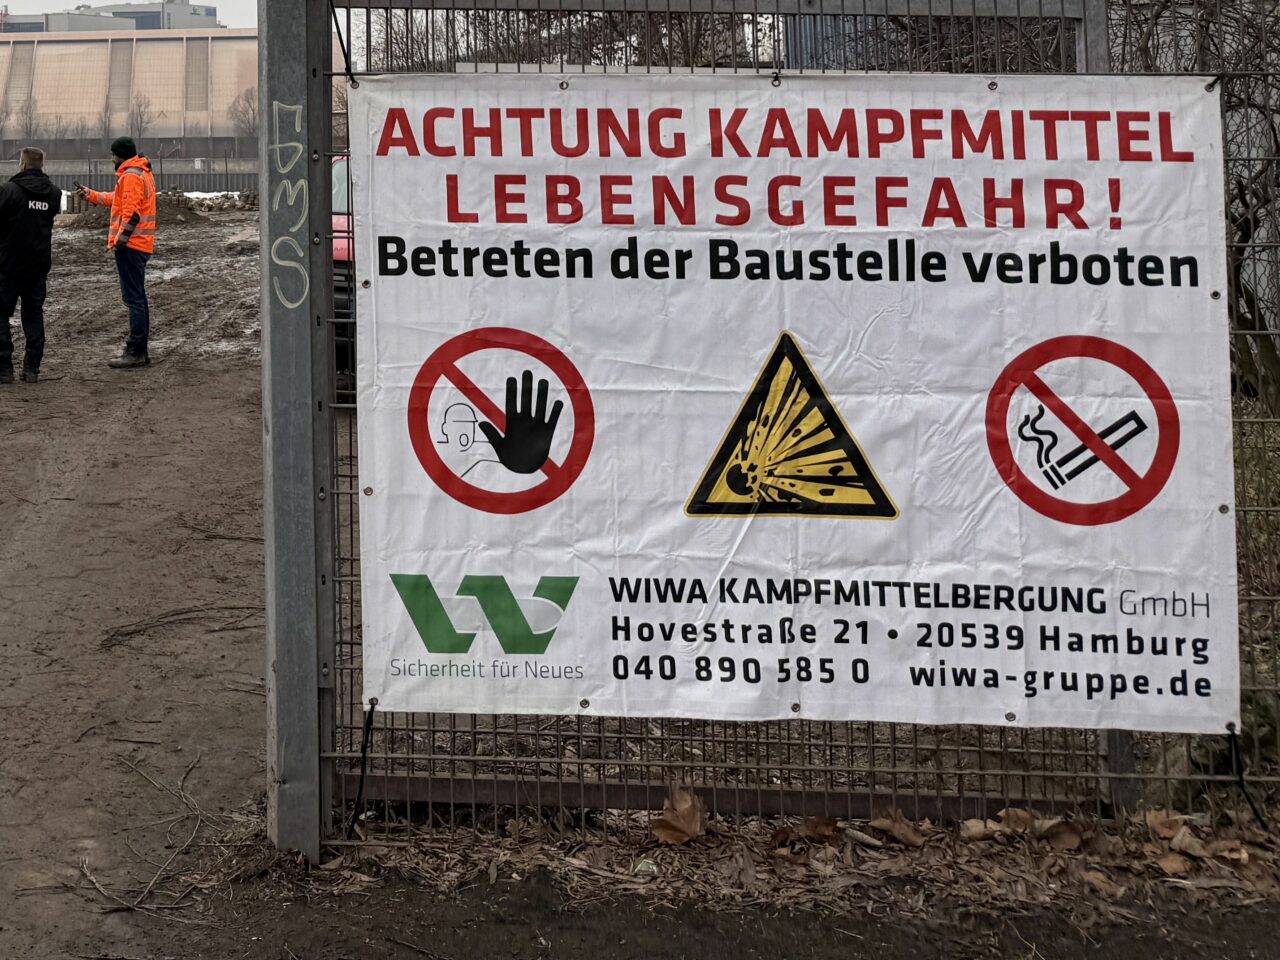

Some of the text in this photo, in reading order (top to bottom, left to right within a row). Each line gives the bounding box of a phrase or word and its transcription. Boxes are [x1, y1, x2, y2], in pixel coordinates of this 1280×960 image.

[375, 107, 1195, 163] ACHTUNG KAMPFMITTEL
[28, 200, 49, 210] KRD
[445, 173, 1122, 231] LEBENSGEFAHR!
[377, 235, 1199, 288] Betreten der Baustelle verboten
[608, 576, 1210, 619] WIWA KAMPFMITTELBERGUNG GmbH
[611, 615, 1210, 666] Hovestraße 21 20539 Hamburg
[390, 658, 584, 680] Sicherheit für Neues
[612, 654, 870, 684] 040 890 585 0
[909, 658, 1212, 701] wiwa-gruppe.de
